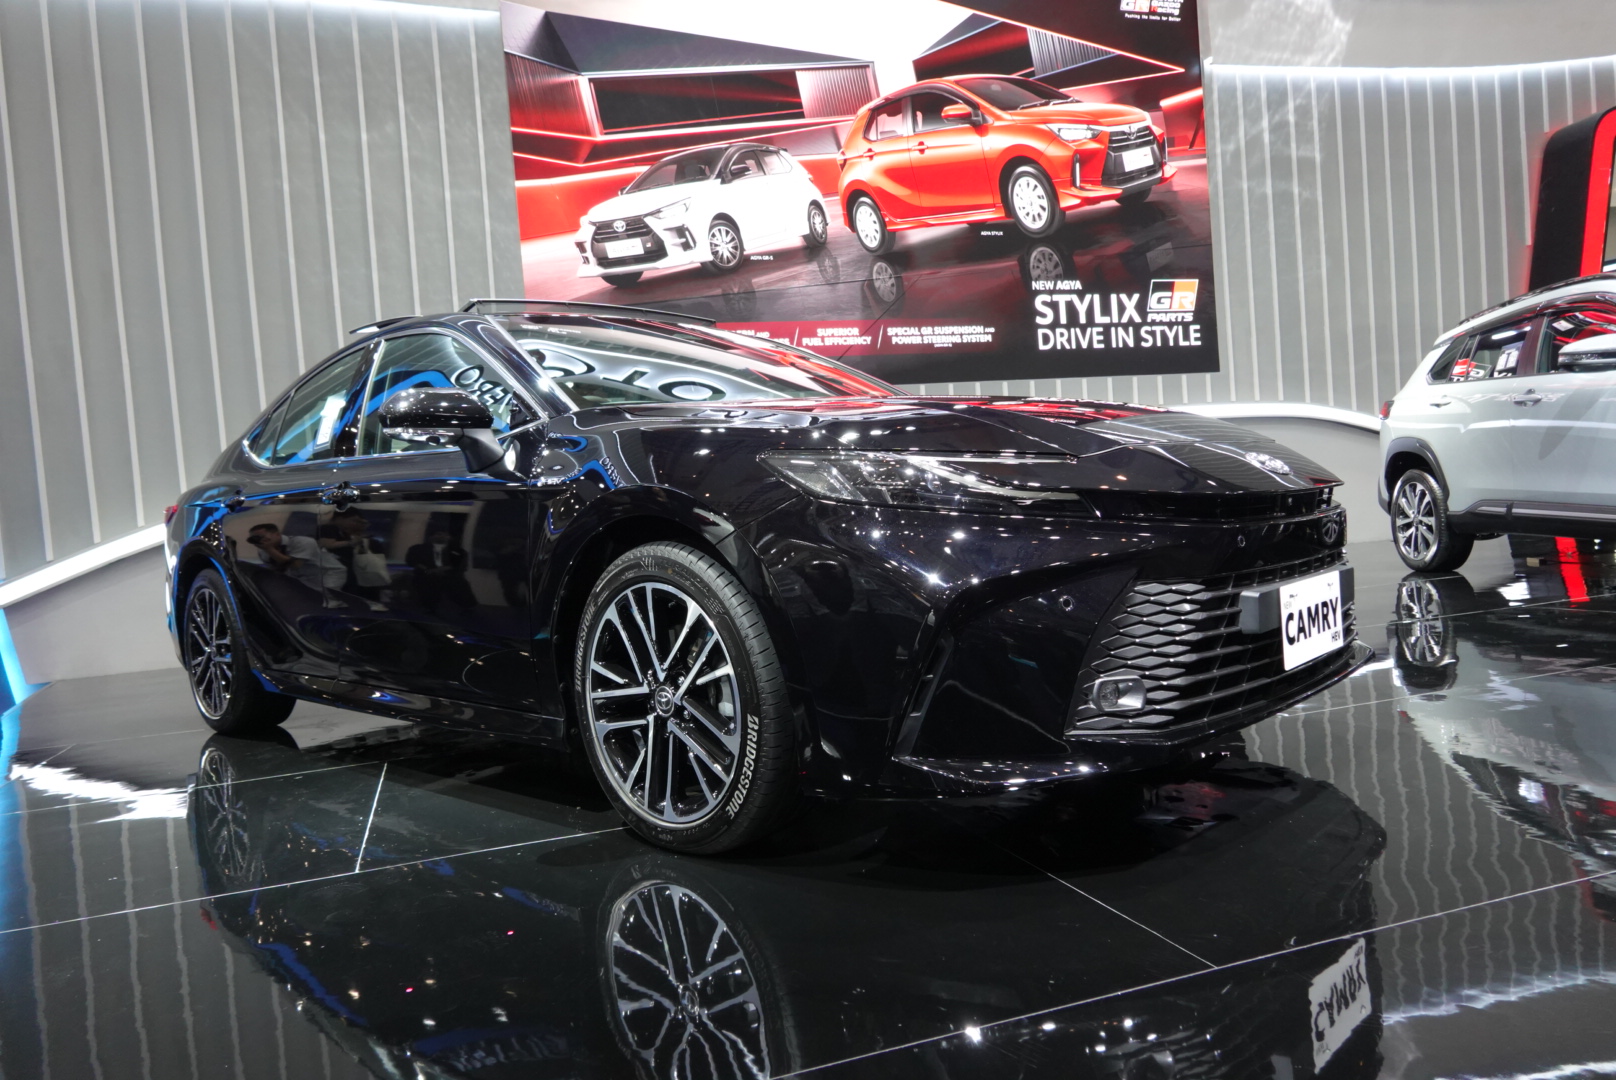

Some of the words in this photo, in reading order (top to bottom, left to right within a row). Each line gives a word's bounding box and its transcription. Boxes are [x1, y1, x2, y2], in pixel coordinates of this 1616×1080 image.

[1032, 281, 1054, 290] NEW
[1056, 280, 1082, 290] AGYA
[1150, 291, 1195, 309] GR
[1034, 293, 1142, 325] STYLIX
[1147, 312, 1193, 322] PARTS
[817, 328, 859, 336] SUPERIOR
[887, 327, 920, 336] SPECIAL
[920, 326, 933, 335] GR
[934, 326, 984, 334] SUSPENSION
[1037, 327, 1105, 350] DRIVE
[1111, 326, 1134, 348] IN
[1140, 325, 1201, 347] STYLE
[802, 338, 823, 346] FUEL
[824, 336, 872, 346] EFFICIENCY
[892, 336, 922, 344] POWER
[924, 334, 961, 344] STEERING
[962, 334, 992, 342] SYSTEM
[1285, 597, 1338, 646] CAMRY
[1331, 630, 1341, 643] HEV
[575, 599, 596, 693] BRIDGESTONE
[725, 713, 759, 819] BRIDGESTONE
